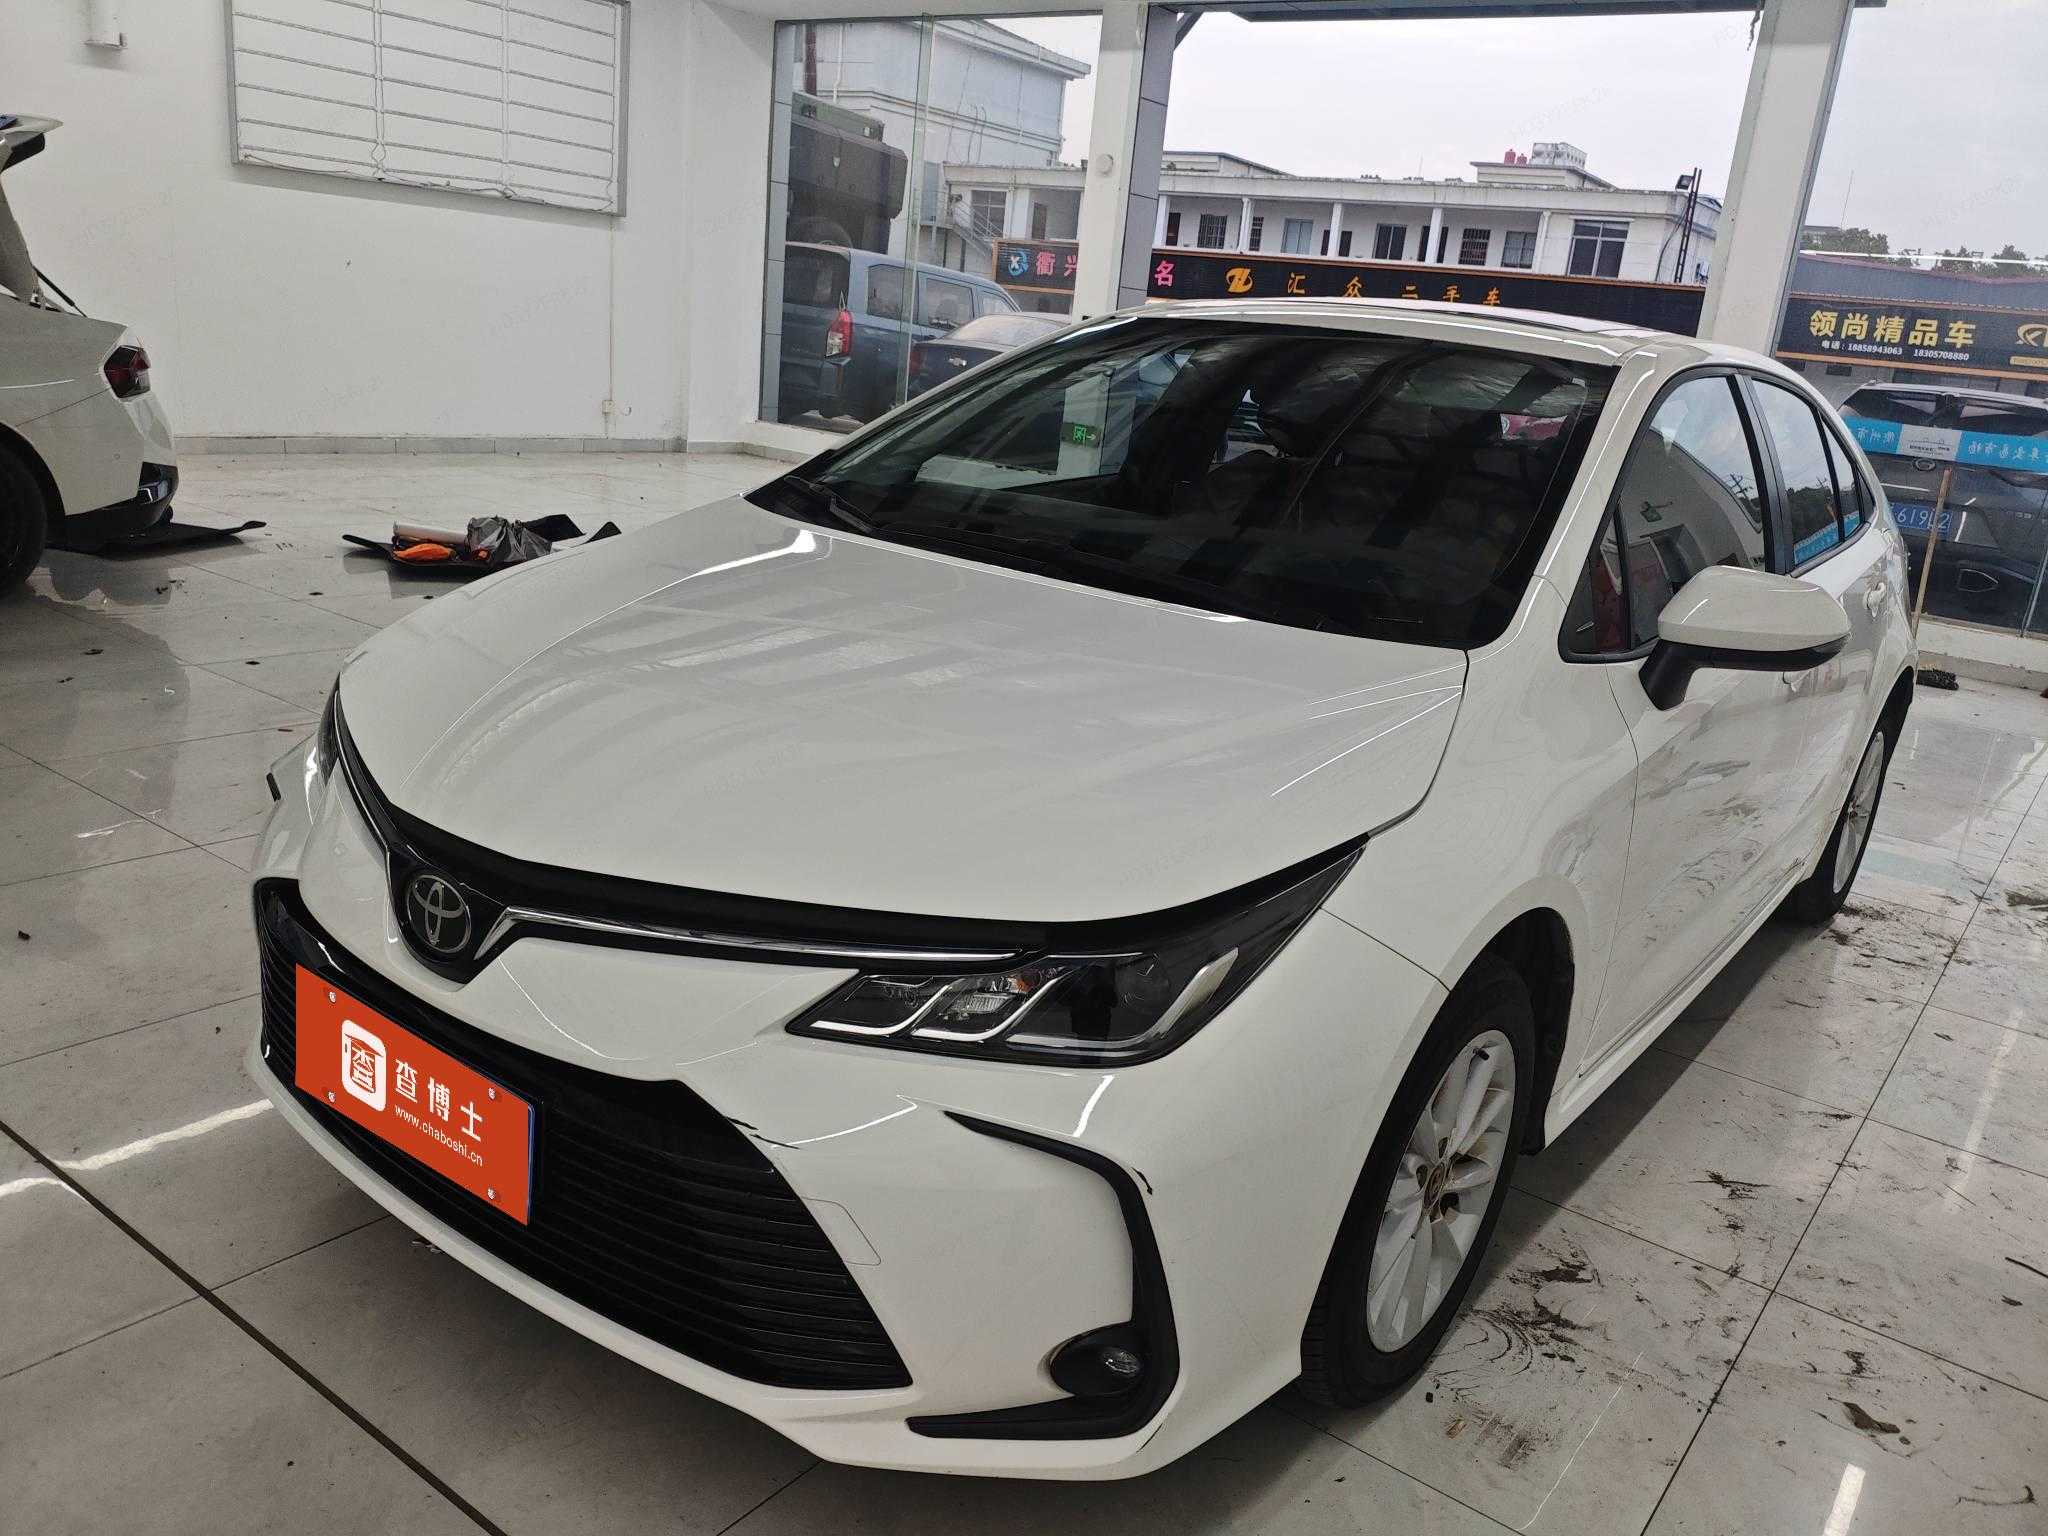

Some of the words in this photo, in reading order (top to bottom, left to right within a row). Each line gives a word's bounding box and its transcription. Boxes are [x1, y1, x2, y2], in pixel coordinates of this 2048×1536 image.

[1155, 260, 1175, 287] 名
[1809, 309, 1976, 348] 领尚精品车
[395, 1059, 483, 1142] 查博士
[394, 1105, 483, 1167] www.chaboshi.cn
